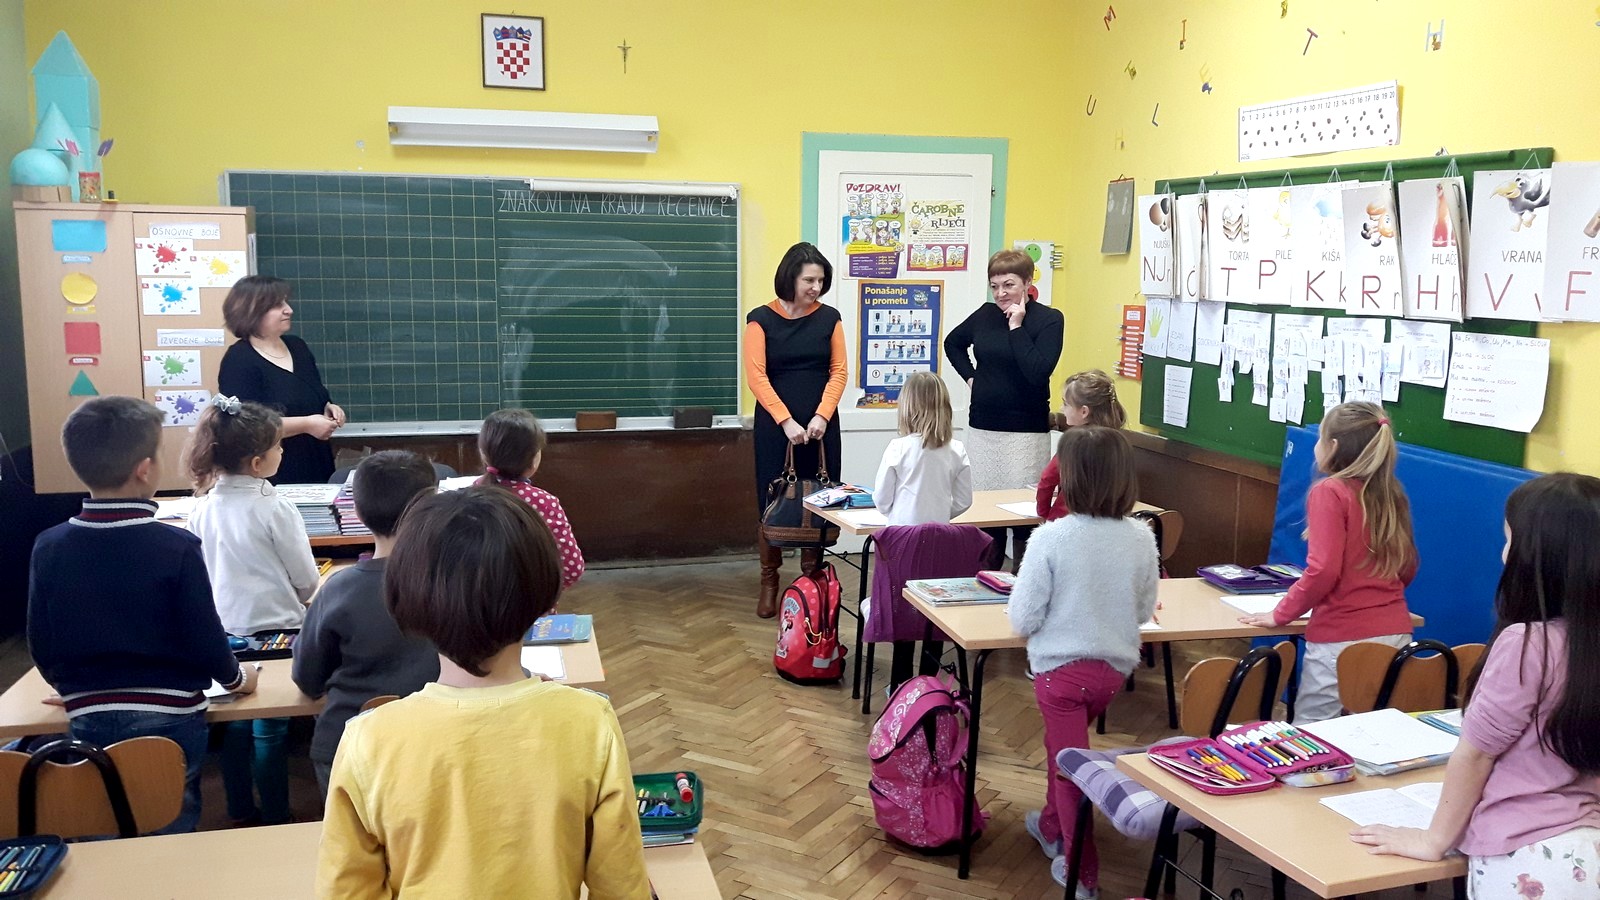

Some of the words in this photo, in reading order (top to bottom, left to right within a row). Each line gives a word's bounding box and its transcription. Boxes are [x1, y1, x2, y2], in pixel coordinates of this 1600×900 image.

[1304, 28, 1318, 56] T
[1086, 95, 1097, 116] U
[1151, 103, 1159, 127] L
[498, 190, 562, 213] ZNAKOVI
[570, 192, 591, 214] NA
[600, 192, 645, 215] KRAJU
[912, 202, 964, 218] ČAROBNE
[152, 227, 194, 237] OSNOVNE
[201, 228, 219, 237] BOJE
[931, 216, 966, 230] RIJEČI
[1228, 250, 1249, 260] TORTA
[1276, 250, 1292, 260] PILE
[1322, 248, 1340, 262] KIŠA
[1379, 255, 1395, 265] RAK
[1502, 250, 1543, 264] VRANA
[1220, 267, 1237, 296] T
[1258, 259, 1277, 290] P
[864, 286, 908, 295] Ponašanje
[1306, 270, 1325, 302] K
[1362, 275, 1381, 309] R
[1417, 274, 1439, 310] H
[1484, 273, 1514, 311] V
[1566, 271, 1592, 311] F
[872, 297, 908, 306] prometu
[160, 337, 199, 345] IZVEDENE
